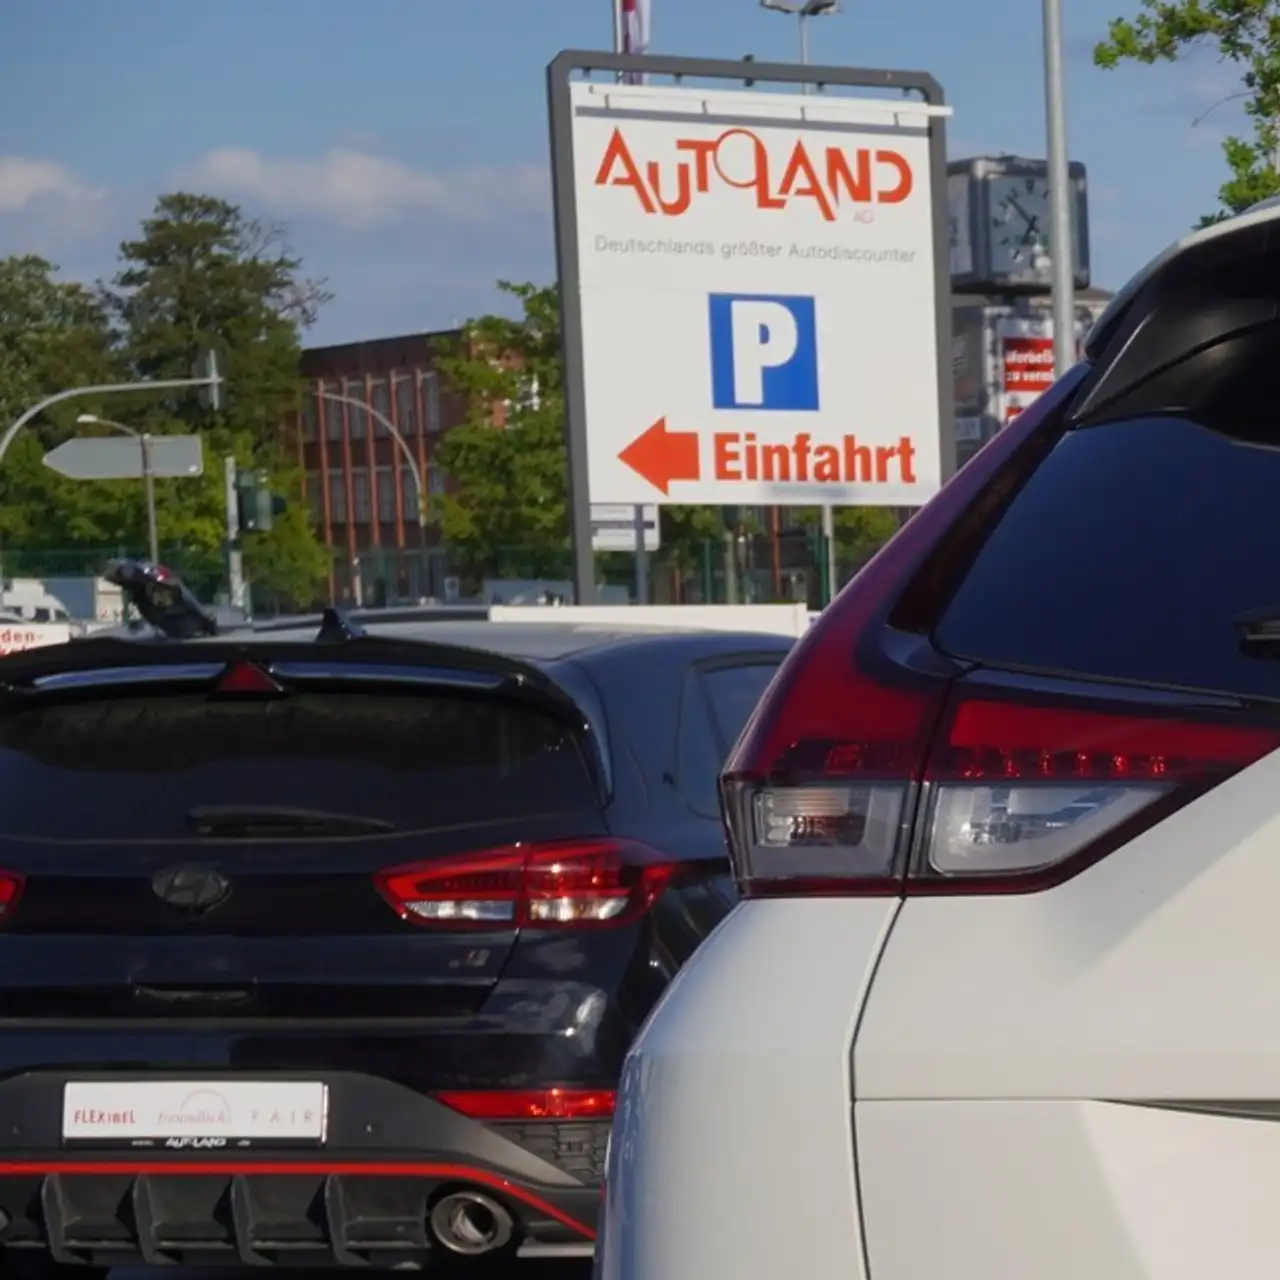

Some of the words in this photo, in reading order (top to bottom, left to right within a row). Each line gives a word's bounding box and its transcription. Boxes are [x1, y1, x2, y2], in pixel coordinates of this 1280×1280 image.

[594, 126, 914, 221] AUTOLAND
[594, 234, 716, 257] Deutschlands
[720, 240, 783, 260] größter
[788, 243, 917, 264] Autodiscounter
[731, 300, 798, 405] P
[712, 431, 916, 485] Einfahrt
[74, 1110, 135, 1124] FLEXIBEL
